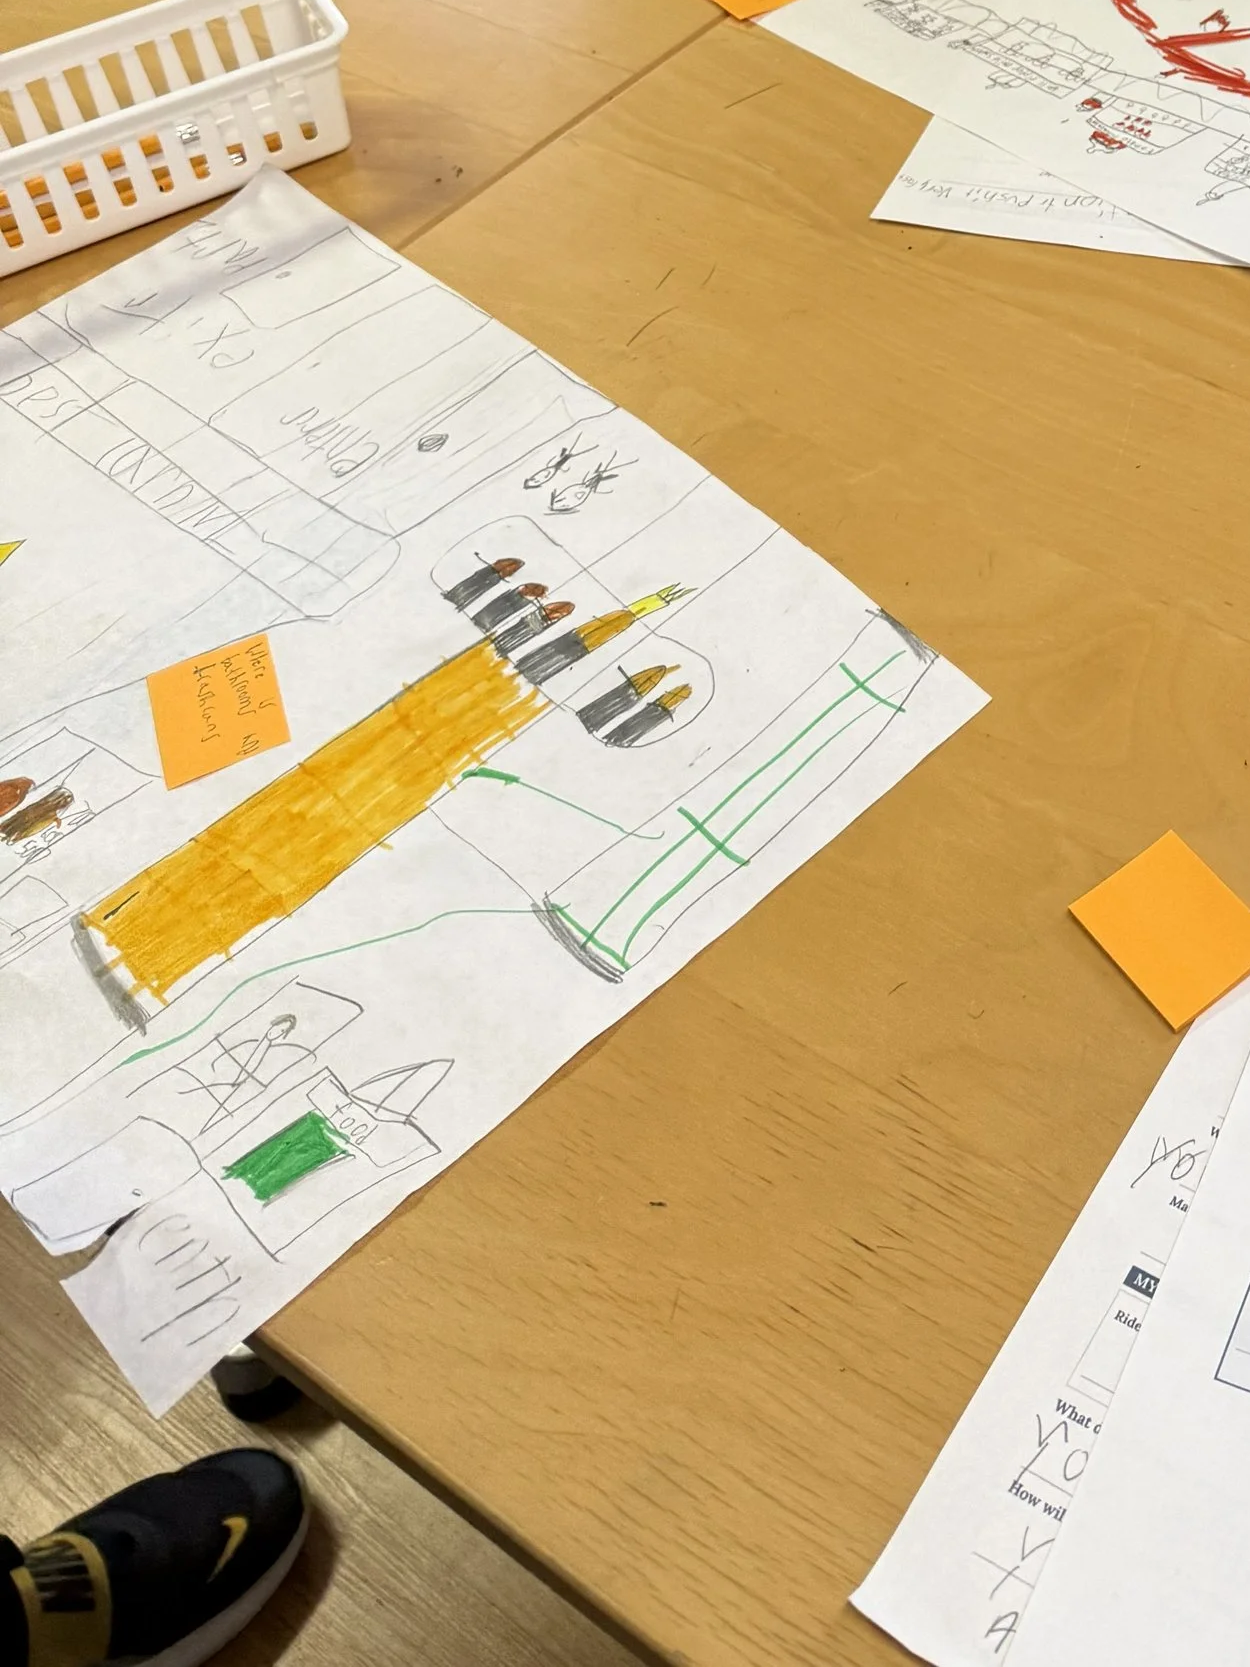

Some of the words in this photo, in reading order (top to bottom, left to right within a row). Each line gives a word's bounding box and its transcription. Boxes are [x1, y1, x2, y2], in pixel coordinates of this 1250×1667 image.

[221, 656, 257, 717] bathrooms
[1114, 1309, 1142, 1332] Ride
[1055, 1398, 1093, 1430] What
[1008, 1480, 1042, 1508] How
